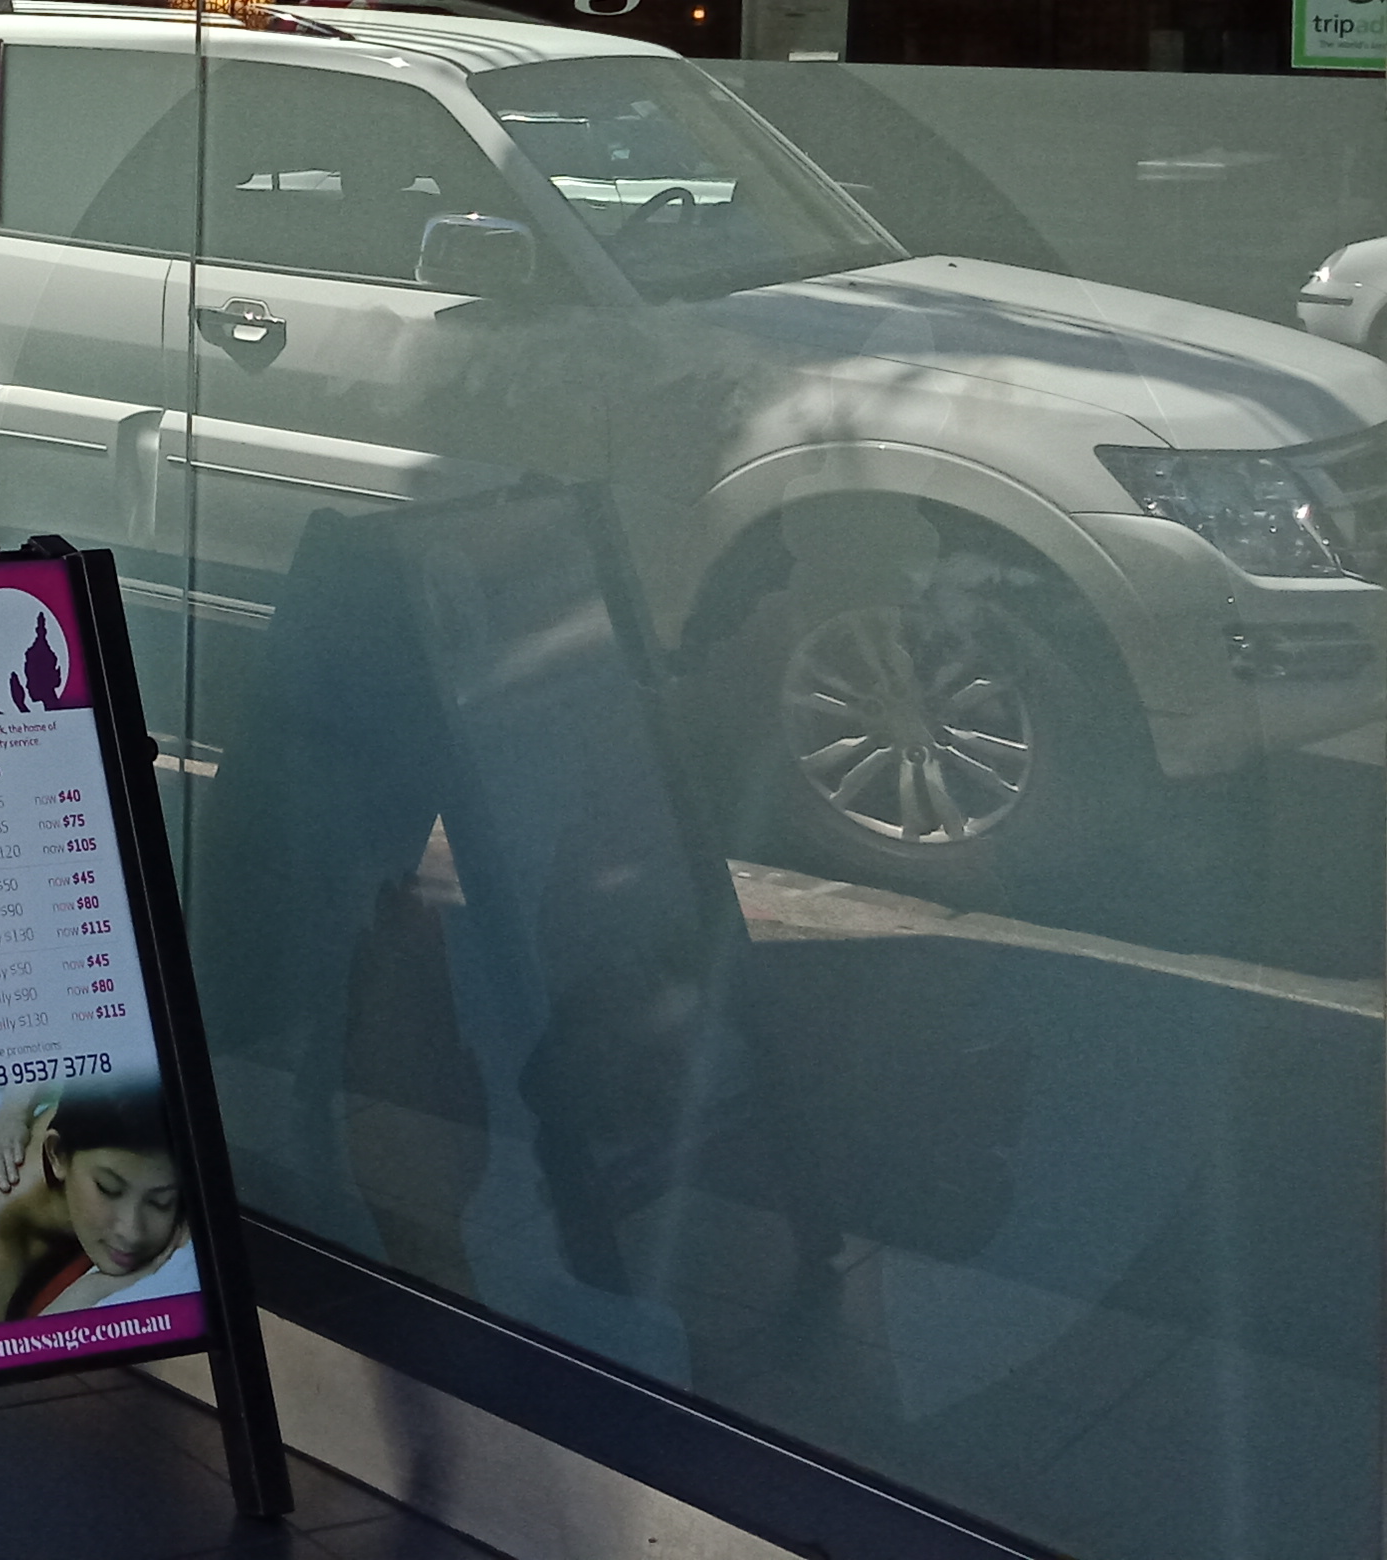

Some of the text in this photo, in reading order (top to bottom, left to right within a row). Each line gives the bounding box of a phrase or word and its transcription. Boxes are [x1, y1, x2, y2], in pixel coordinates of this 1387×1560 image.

[34, 795, 56, 806] now
[58, 789, 81, 803] $40
[11, 1058, 60, 1085] 9537
[64, 1053, 112, 1078] 3778
